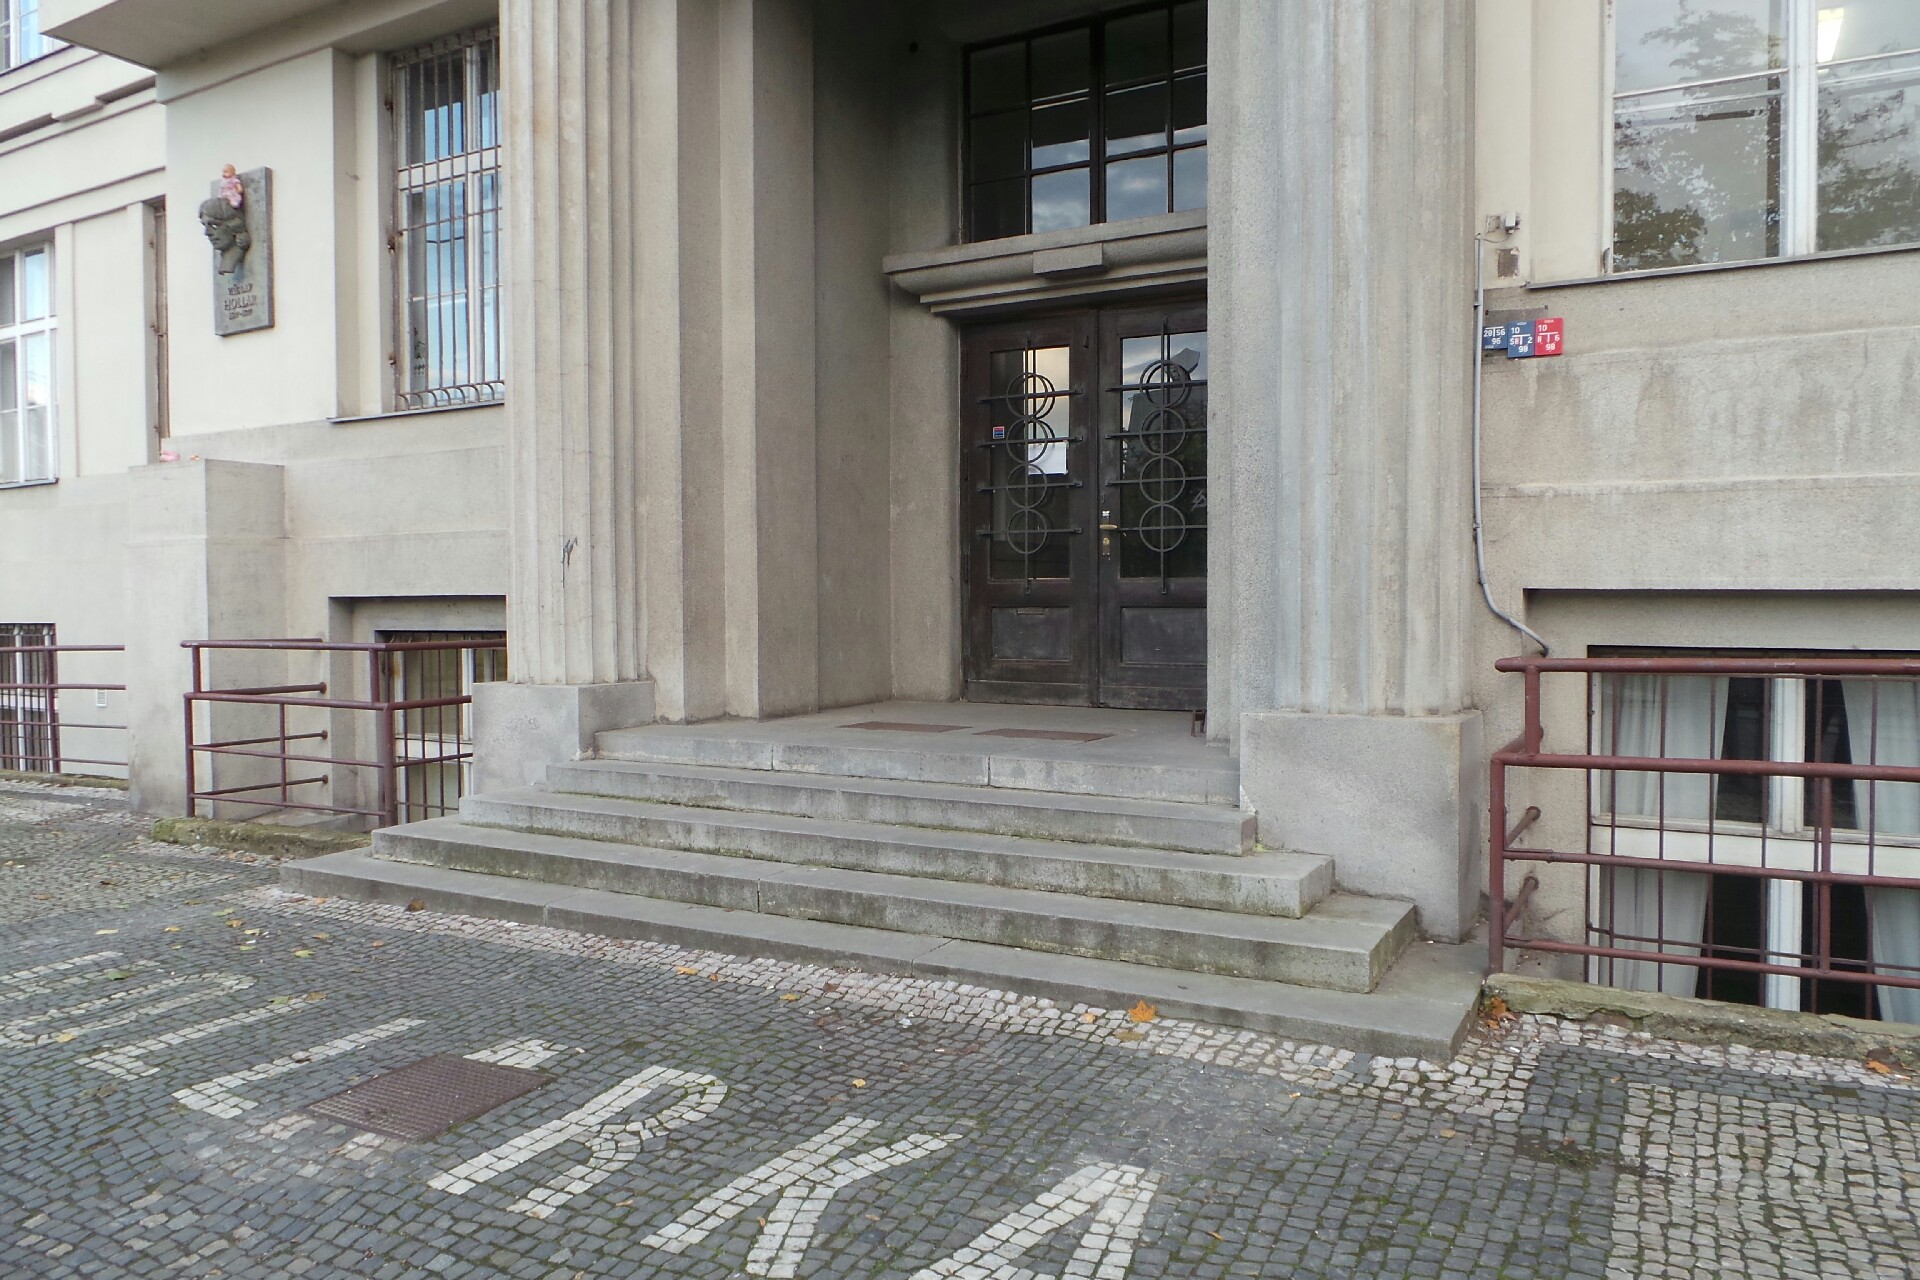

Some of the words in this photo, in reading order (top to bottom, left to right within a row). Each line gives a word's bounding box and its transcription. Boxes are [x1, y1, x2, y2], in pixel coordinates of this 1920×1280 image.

[1511, 326, 1520, 334] 10
[1537, 324, 1548, 332] 10
[1527, 336, 1533, 344] 2
